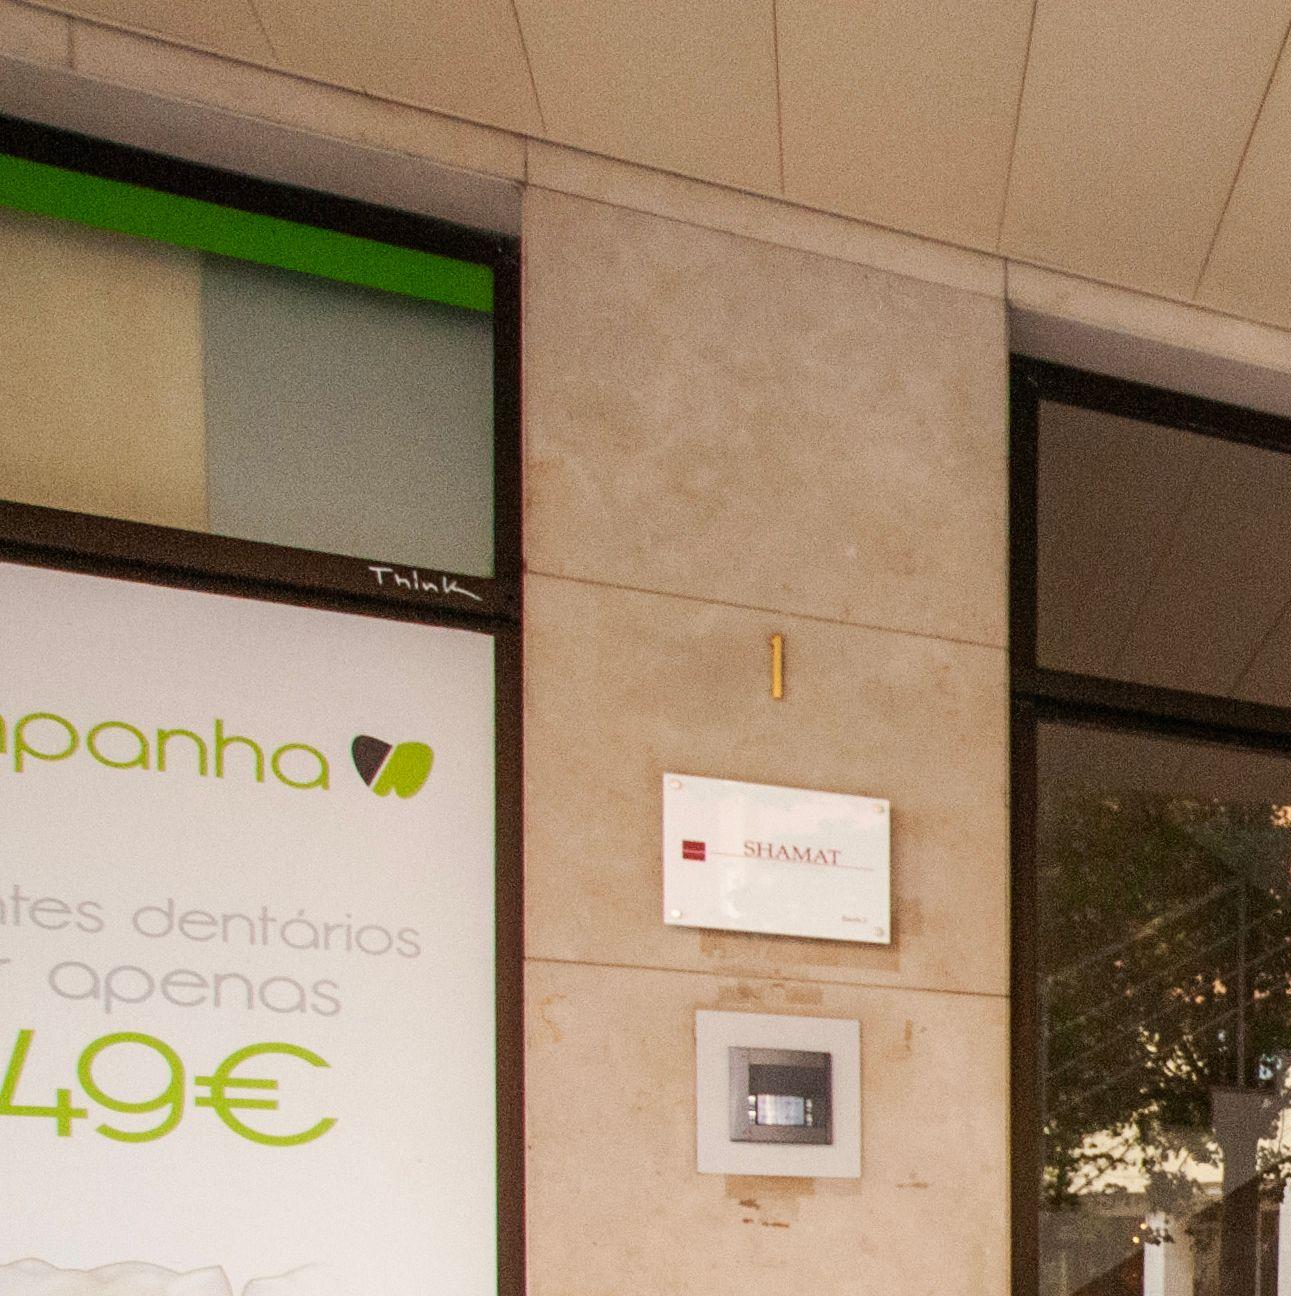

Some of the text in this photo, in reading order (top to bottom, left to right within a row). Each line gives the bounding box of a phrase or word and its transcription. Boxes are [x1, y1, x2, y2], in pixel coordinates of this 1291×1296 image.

[0, 712, 330, 791] panha
[743, 840, 842, 865] SHAMAT
[132, 897, 422, 959] dentários
[49, 960, 342, 1018] apenas
[0, 1028, 339, 1148] 49€
